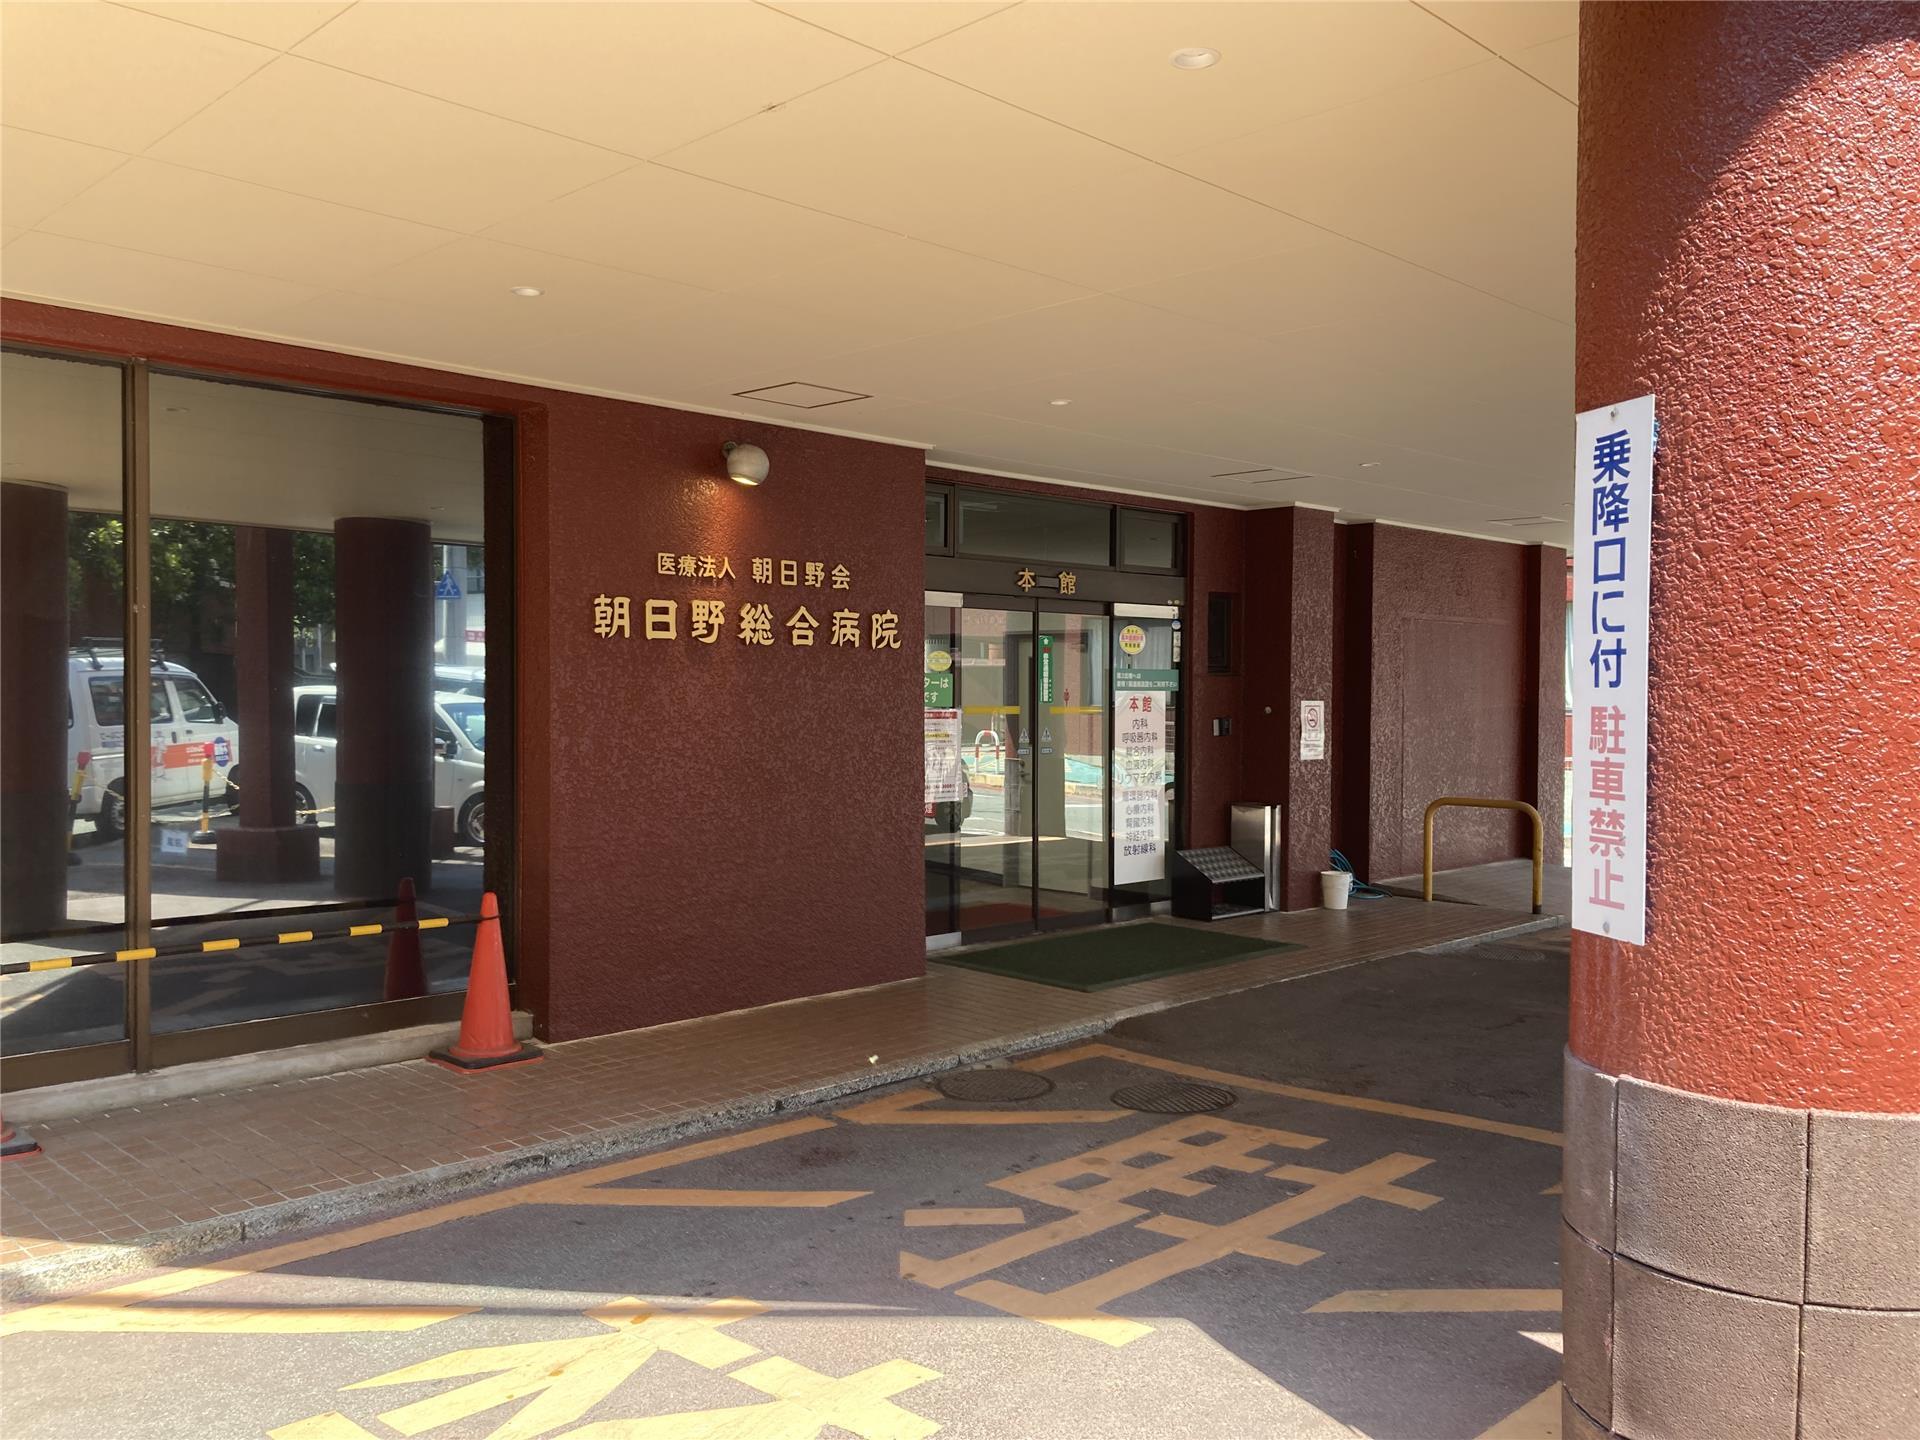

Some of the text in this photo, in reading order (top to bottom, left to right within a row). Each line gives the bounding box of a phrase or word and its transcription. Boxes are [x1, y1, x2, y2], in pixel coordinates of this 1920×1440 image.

[657, 552, 852, 590] 医療法人 朝日野会
[1016, 568, 1077, 596] 本館
[593, 593, 902, 651] 朝日野総合病院
[1587, 428, 1633, 912] 乗降口に付 駐車禁止
[1129, 695, 1152, 713] 本館
[1132, 718, 1148, 730] 内科
[1121, 731, 1158, 743] 呼吸器内科
[1126, 758, 1154, 771] 血液内科
[1117, 772, 1162, 785] リウマチ内科
[1123, 842, 1156, 856] 放射線科
